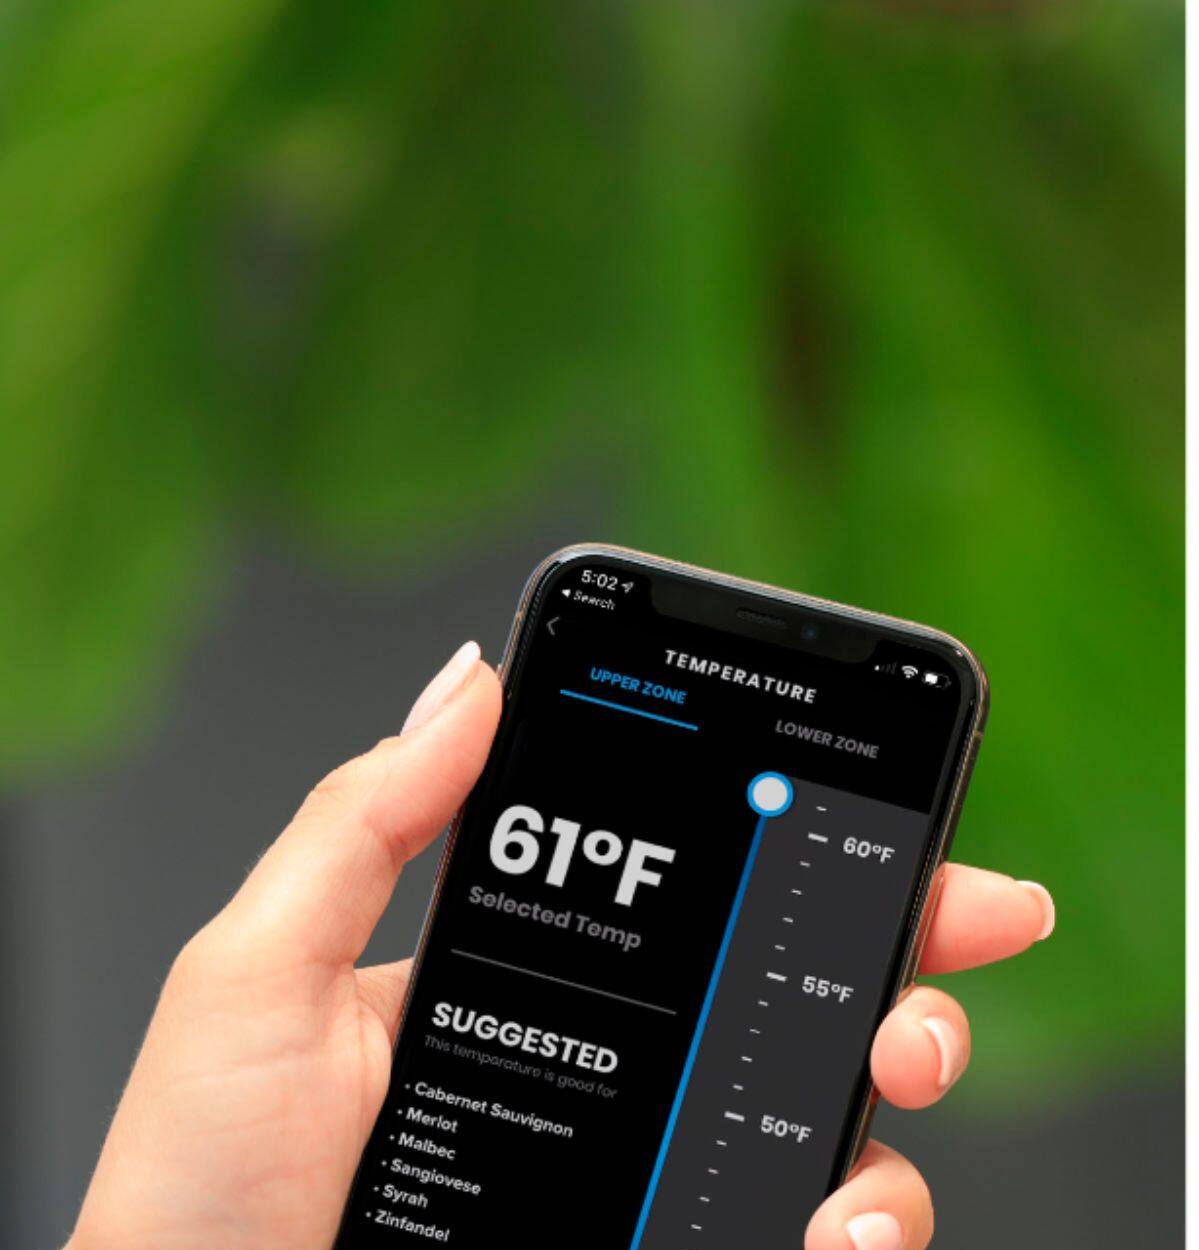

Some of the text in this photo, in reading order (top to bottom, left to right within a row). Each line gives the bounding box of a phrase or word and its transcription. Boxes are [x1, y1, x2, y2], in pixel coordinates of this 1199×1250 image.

[581, 569, 619, 591] 5:02
[573, 590, 616, 611] Search
[589, 667, 688, 704] UPPER ZONE
[664, 649, 818, 704] TEMPERATURE
[775, 720, 880, 759] LOWER ZONE
[468, 885, 642, 952] Selected Temp
[431, 1002, 618, 1074] SUGGESTED
[424, 1034, 451, 1052] This
[556, 1074, 595, 1093] good
[405, 1106, 459, 1133] Merlot
[414, 1081, 574, 1138] Cabernet Sauvignon
[397, 1132, 457, 1161] Malbec
[390, 1158, 482, 1195] Sangiovese
[382, 1184, 429, 1208] Syrah
[374, 1209, 450, 1242] Zinfandel
